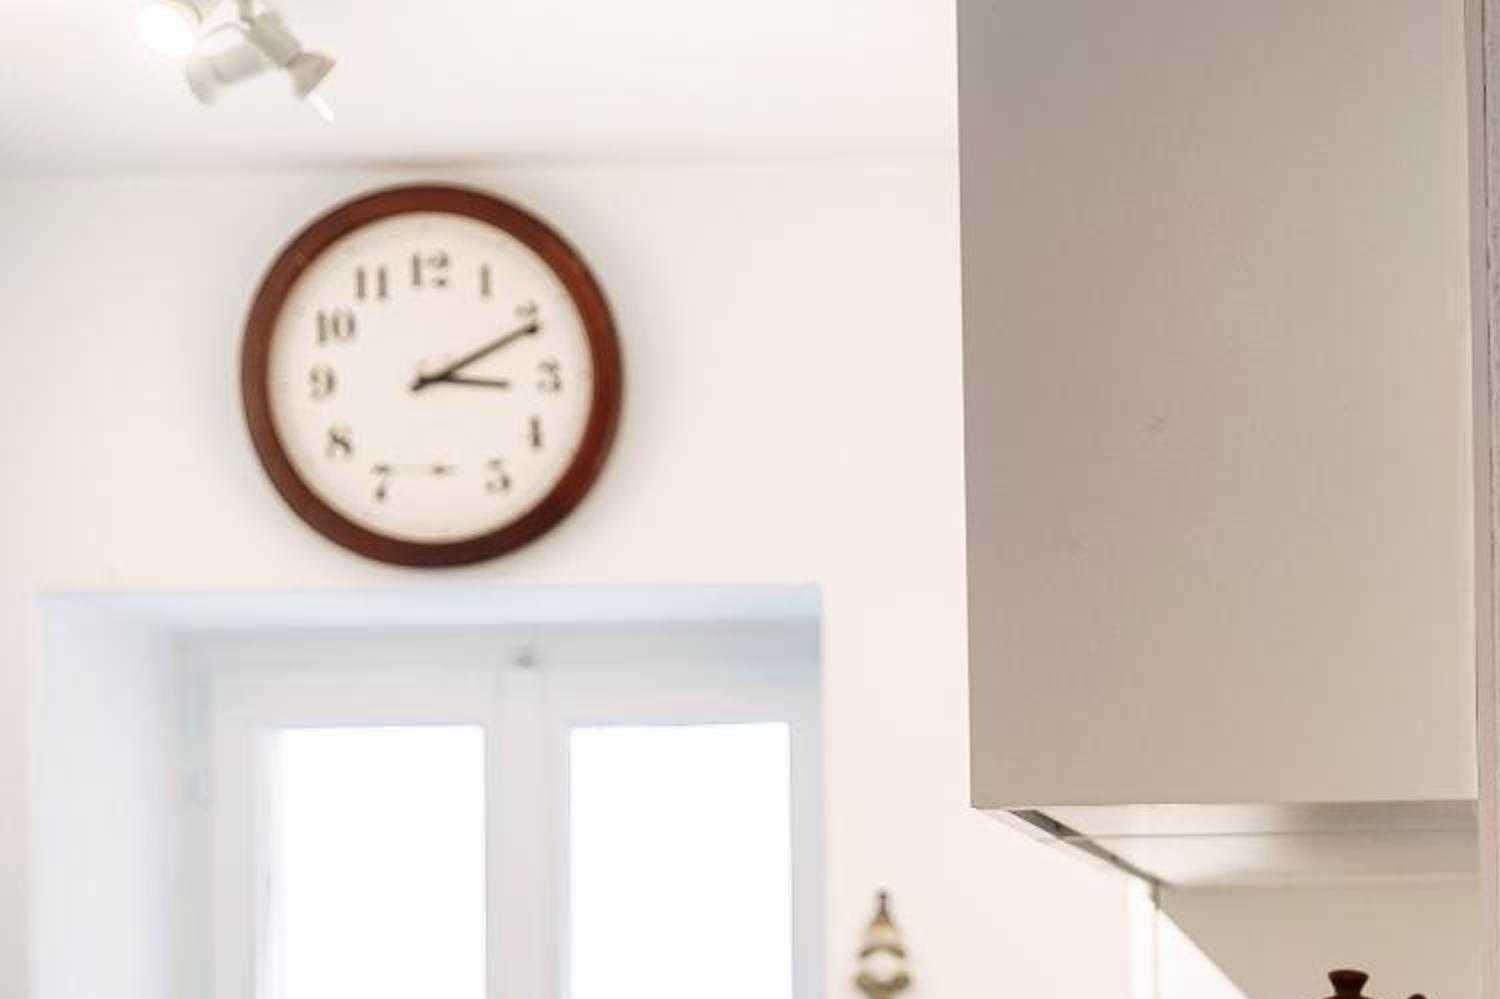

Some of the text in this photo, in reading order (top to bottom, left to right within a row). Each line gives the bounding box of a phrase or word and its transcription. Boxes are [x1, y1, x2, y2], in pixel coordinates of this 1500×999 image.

[354, 266, 388, 300] 11
[411, 250, 452, 289] 12
[479, 263, 491, 297] 1
[316, 308, 356, 344] 10
[309, 365, 336, 400] 9
